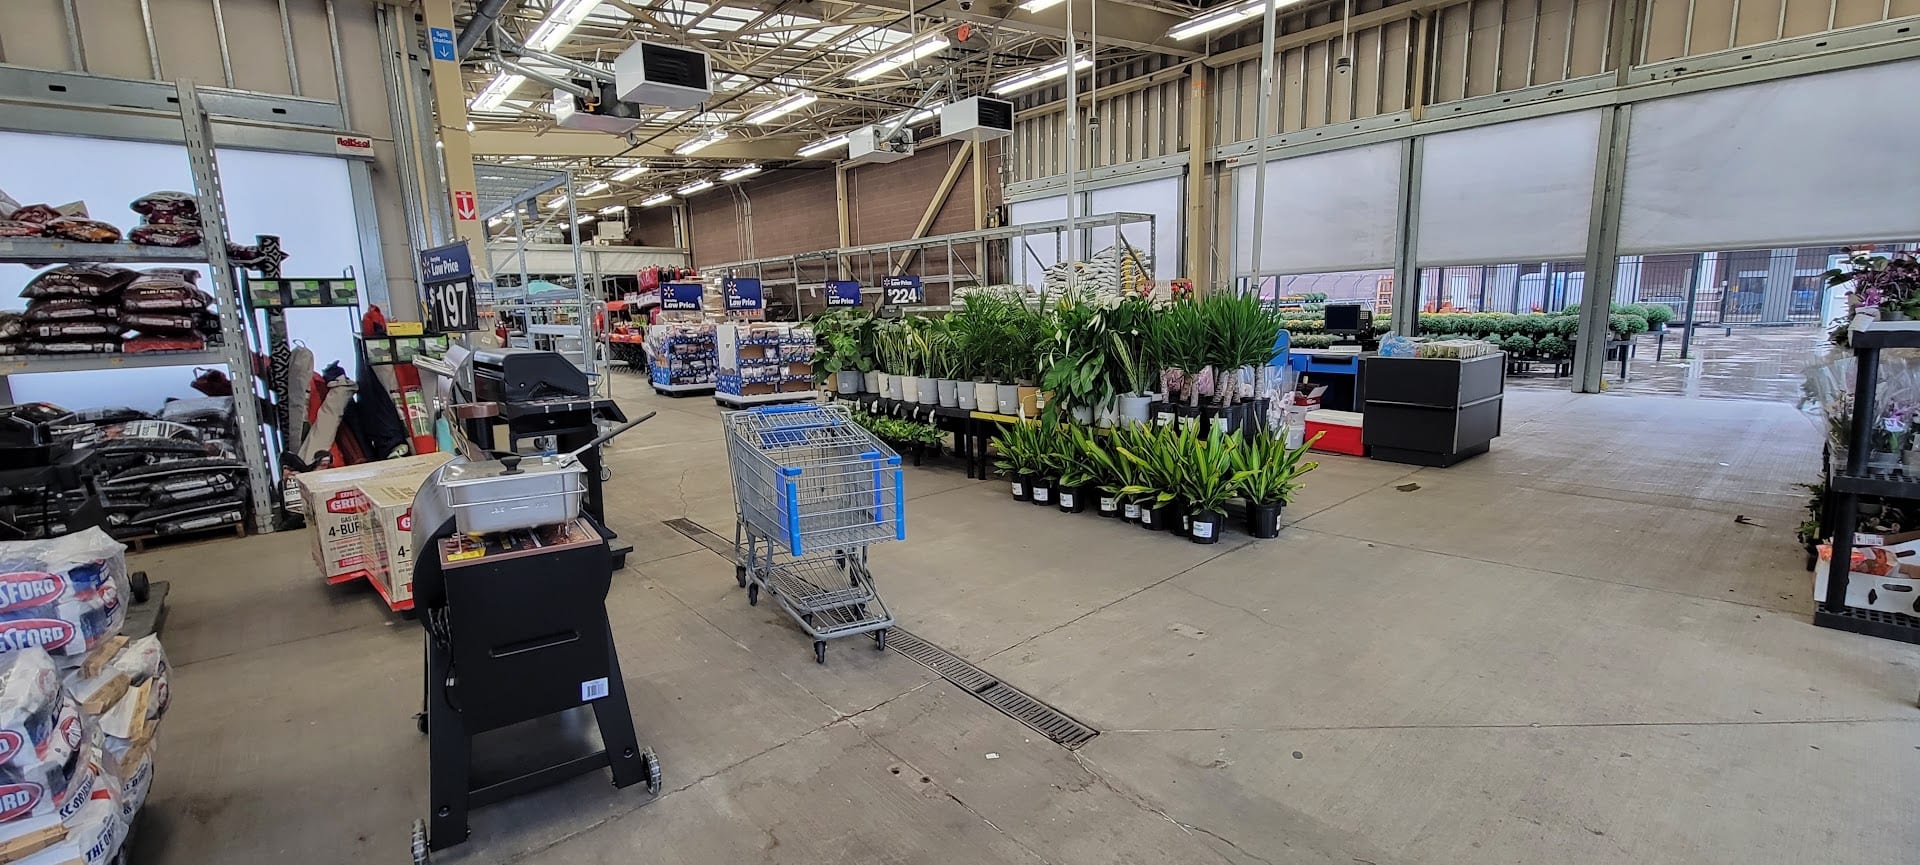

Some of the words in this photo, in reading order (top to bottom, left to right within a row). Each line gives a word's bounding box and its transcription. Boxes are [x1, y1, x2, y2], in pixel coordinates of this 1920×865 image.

[431, 262, 444, 276] Low
[443, 258, 459, 274] Price
[888, 287, 917, 304] $224
[664, 301, 678, 309] Low
[679, 301, 696, 309] Price
[742, 297, 756, 306] Price
[841, 297, 855, 305] Price
